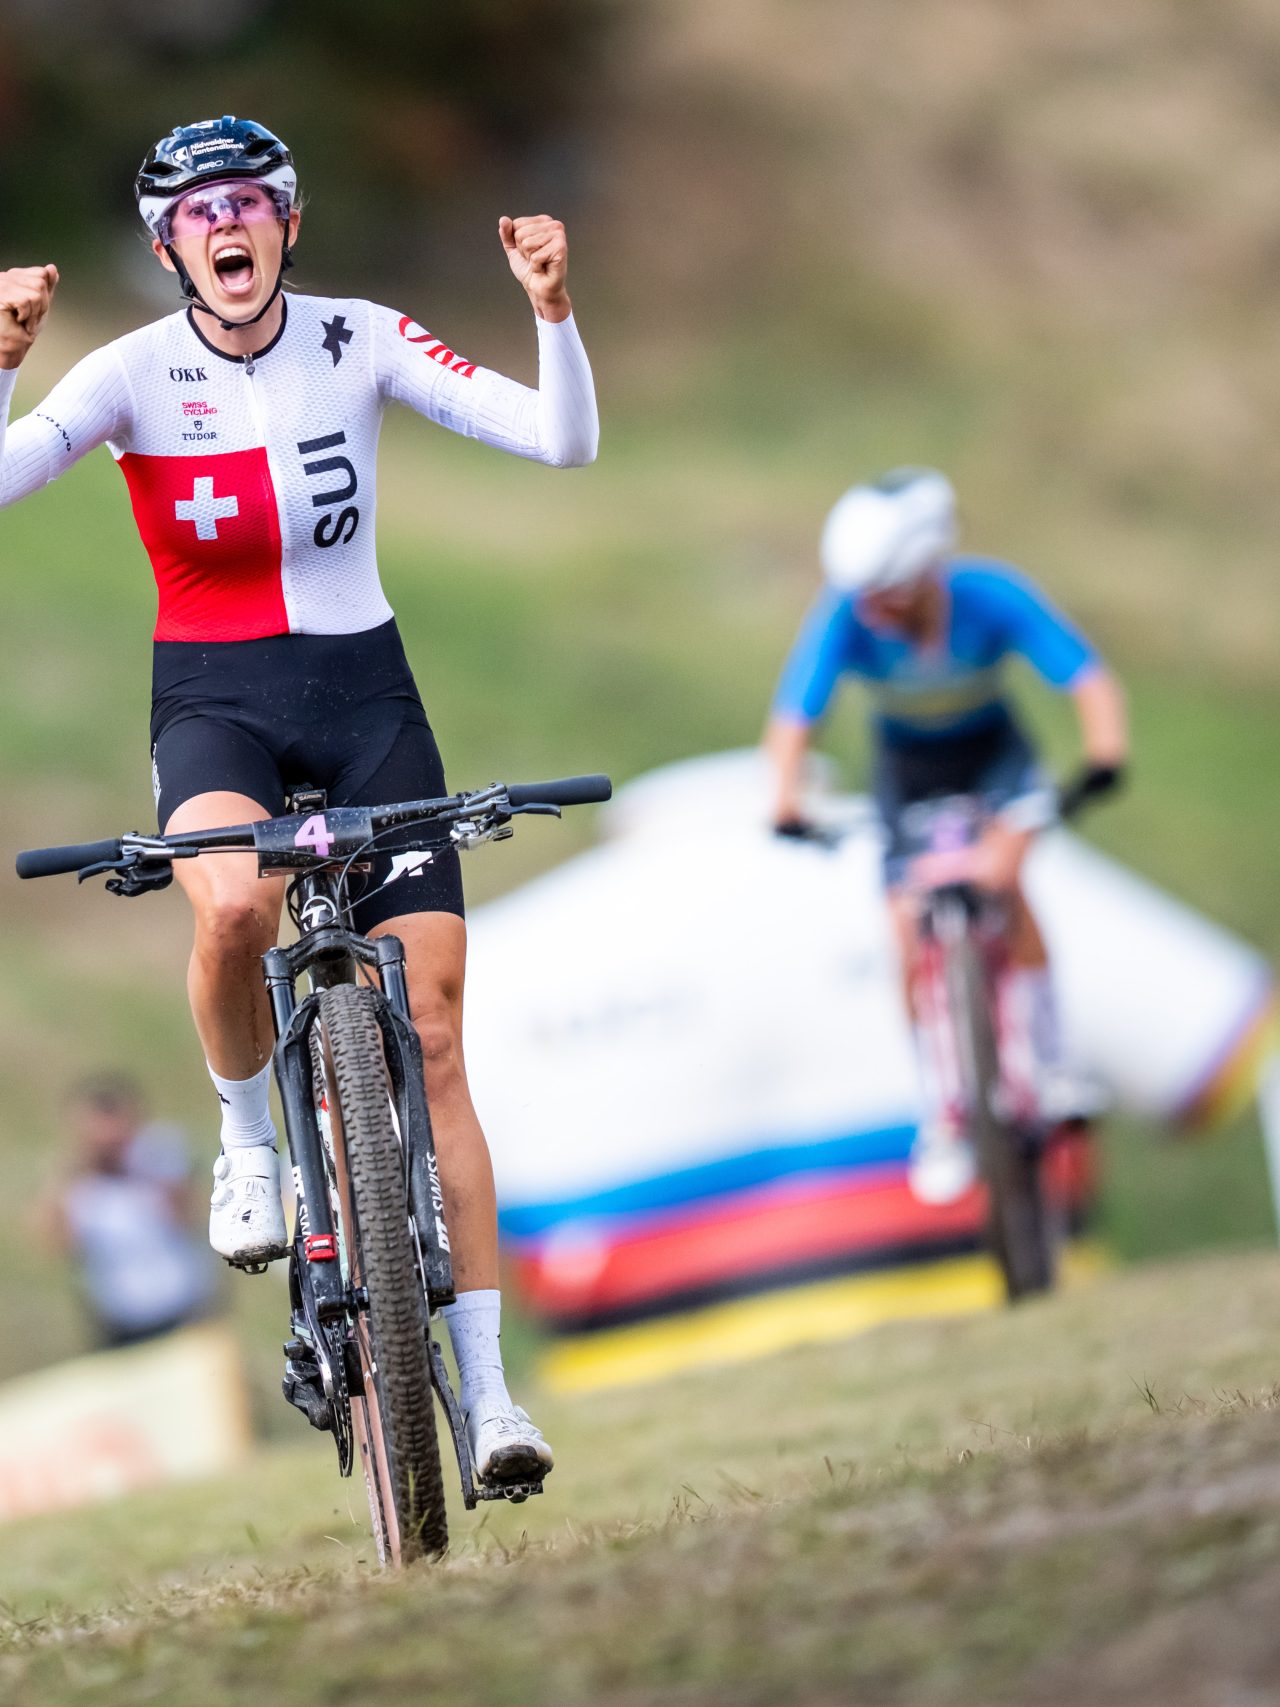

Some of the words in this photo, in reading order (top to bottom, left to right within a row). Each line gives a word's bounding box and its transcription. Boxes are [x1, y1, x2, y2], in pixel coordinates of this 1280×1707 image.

[190, 138, 235, 151] Nidwaldner
[191, 143, 245, 157] Kantonalbank
[197, 160, 224, 171] GIRO
[169, 367, 208, 382] ÖKK
[184, 408, 218, 416] CYCLING
[181, 432, 217, 441] TUDOR
[297, 430, 360, 548] SUI
[294, 814, 335, 857] 4
[426, 1151, 443, 1211] SWISS
